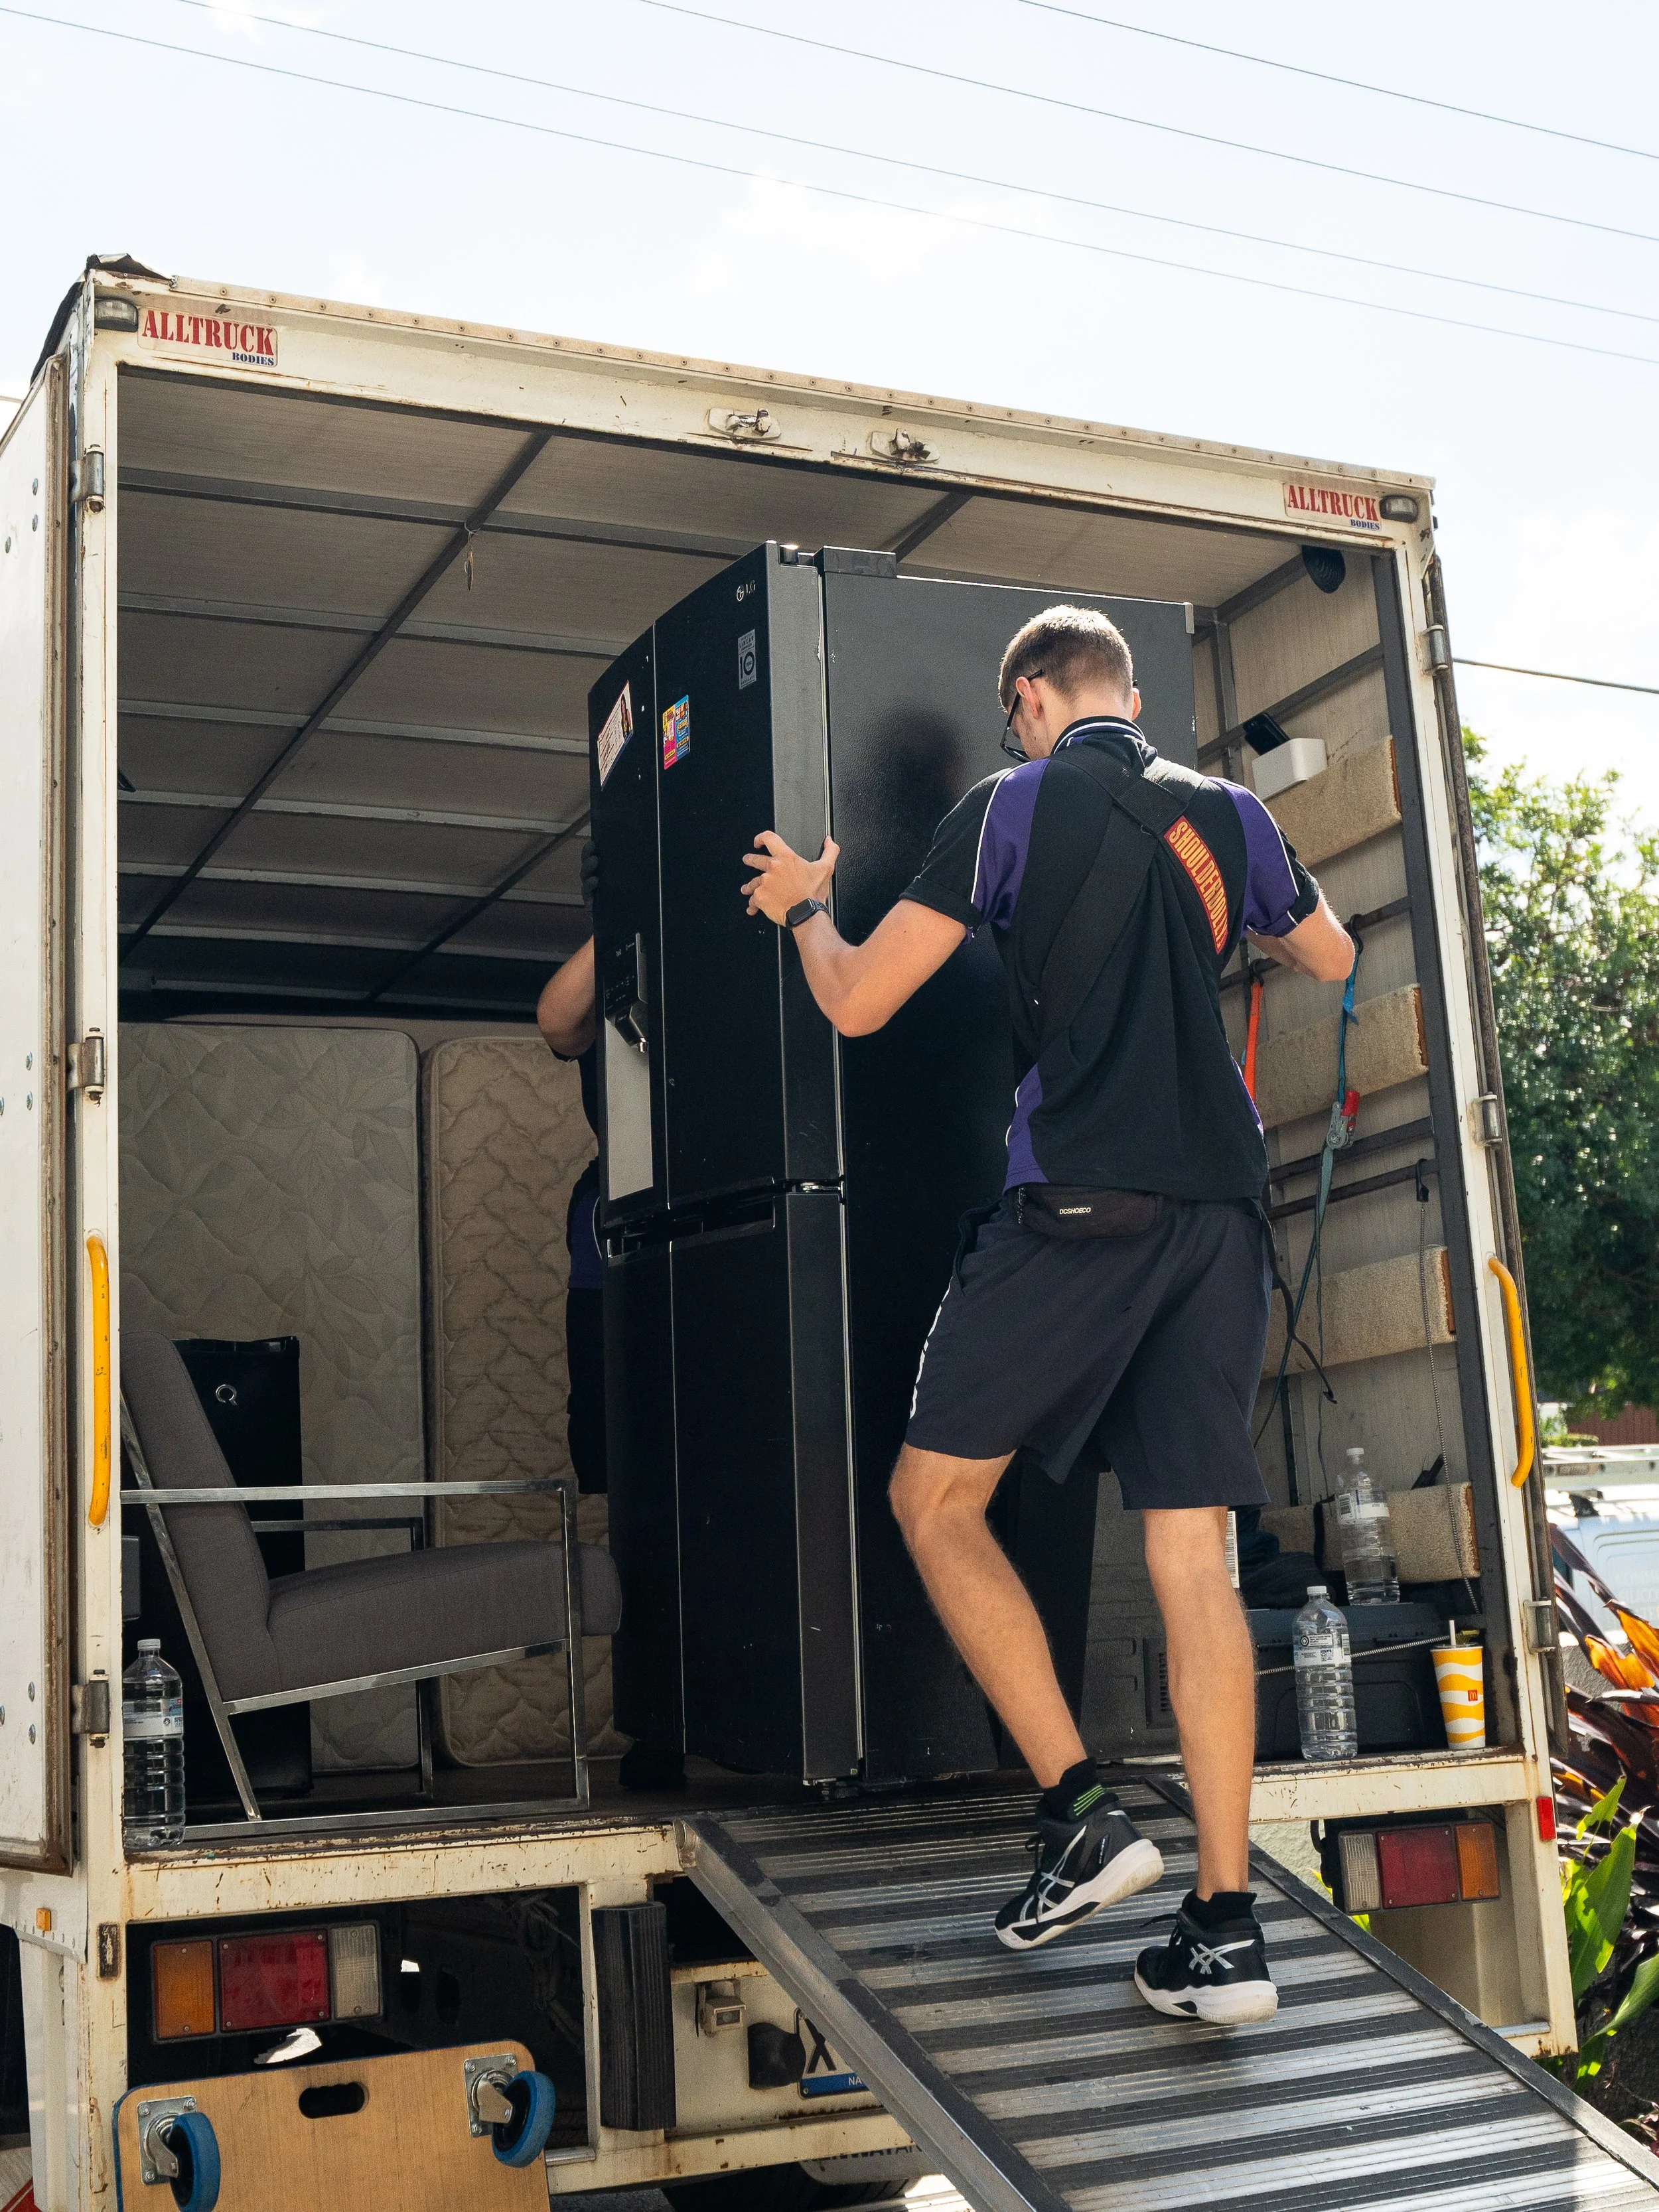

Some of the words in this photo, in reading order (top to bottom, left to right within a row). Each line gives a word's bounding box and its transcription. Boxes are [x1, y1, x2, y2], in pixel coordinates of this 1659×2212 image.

[142, 310, 274, 356] ALLTRUCK
[232, 352, 274, 366] BODIES
[1287, 485, 1379, 521] ALLTRUCK
[1350, 519, 1380, 530] BODIES
[740, 652, 755, 680] 10
